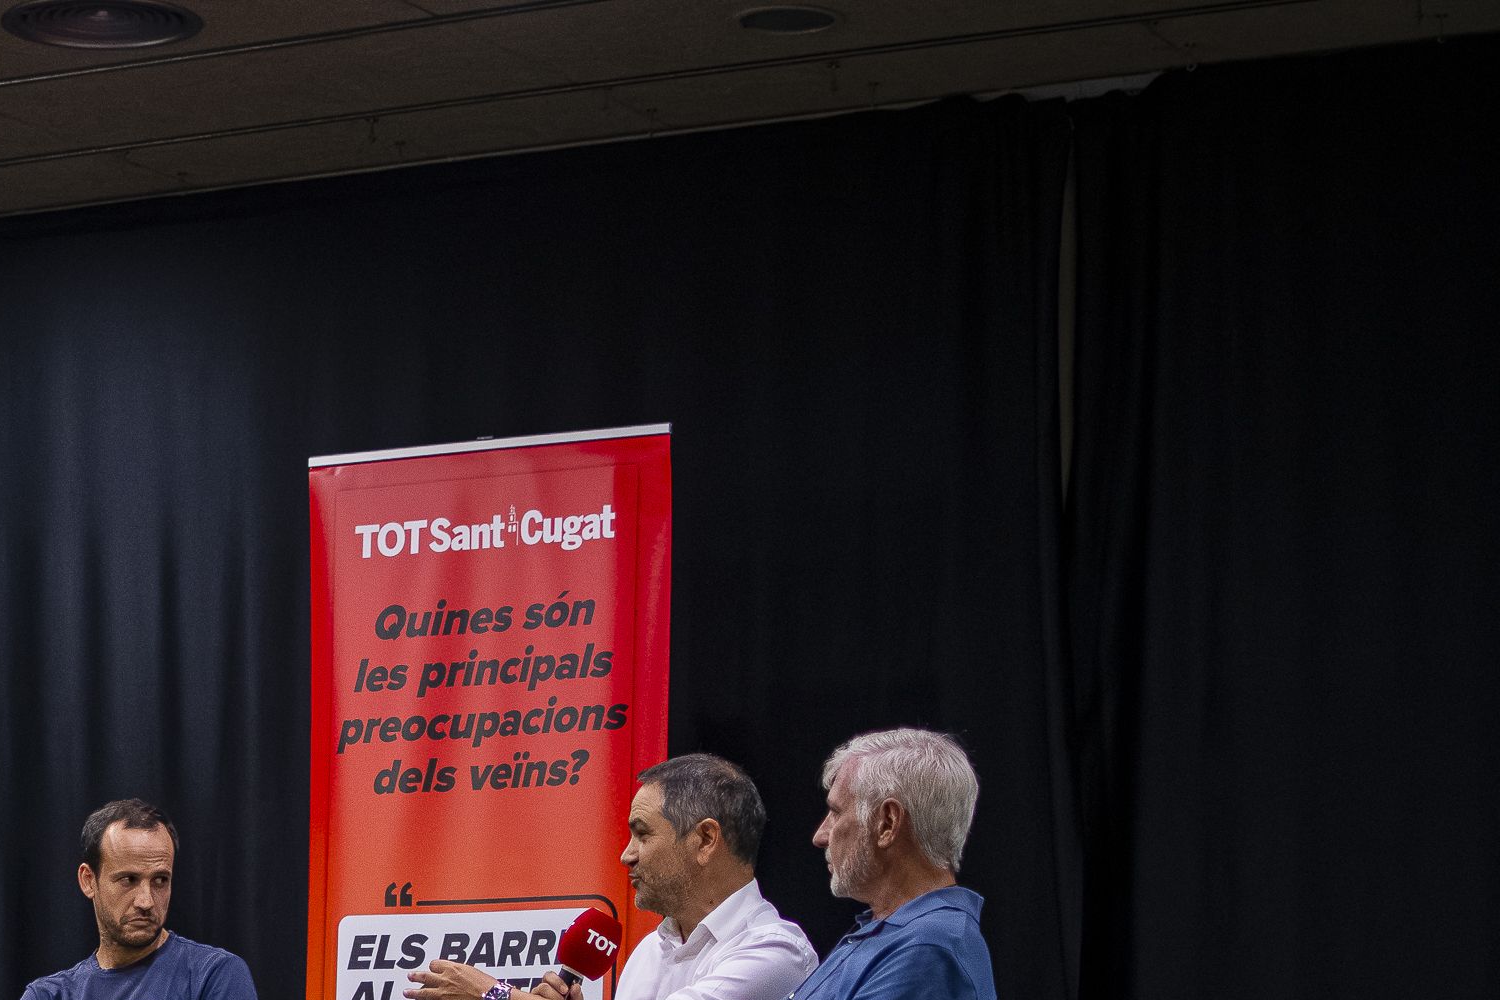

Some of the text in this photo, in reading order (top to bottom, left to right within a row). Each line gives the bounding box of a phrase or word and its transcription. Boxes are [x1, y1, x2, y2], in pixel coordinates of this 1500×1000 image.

[355, 504, 616, 558] TOT Sant Cugat
[375, 591, 596, 640] Quines són
[354, 643, 614, 697] les principals
[337, 696, 628, 754] preocupacions
[373, 750, 590, 795] dels veïns?
[347, 933, 428, 970] ELS
[586, 928, 618, 957] TOT
